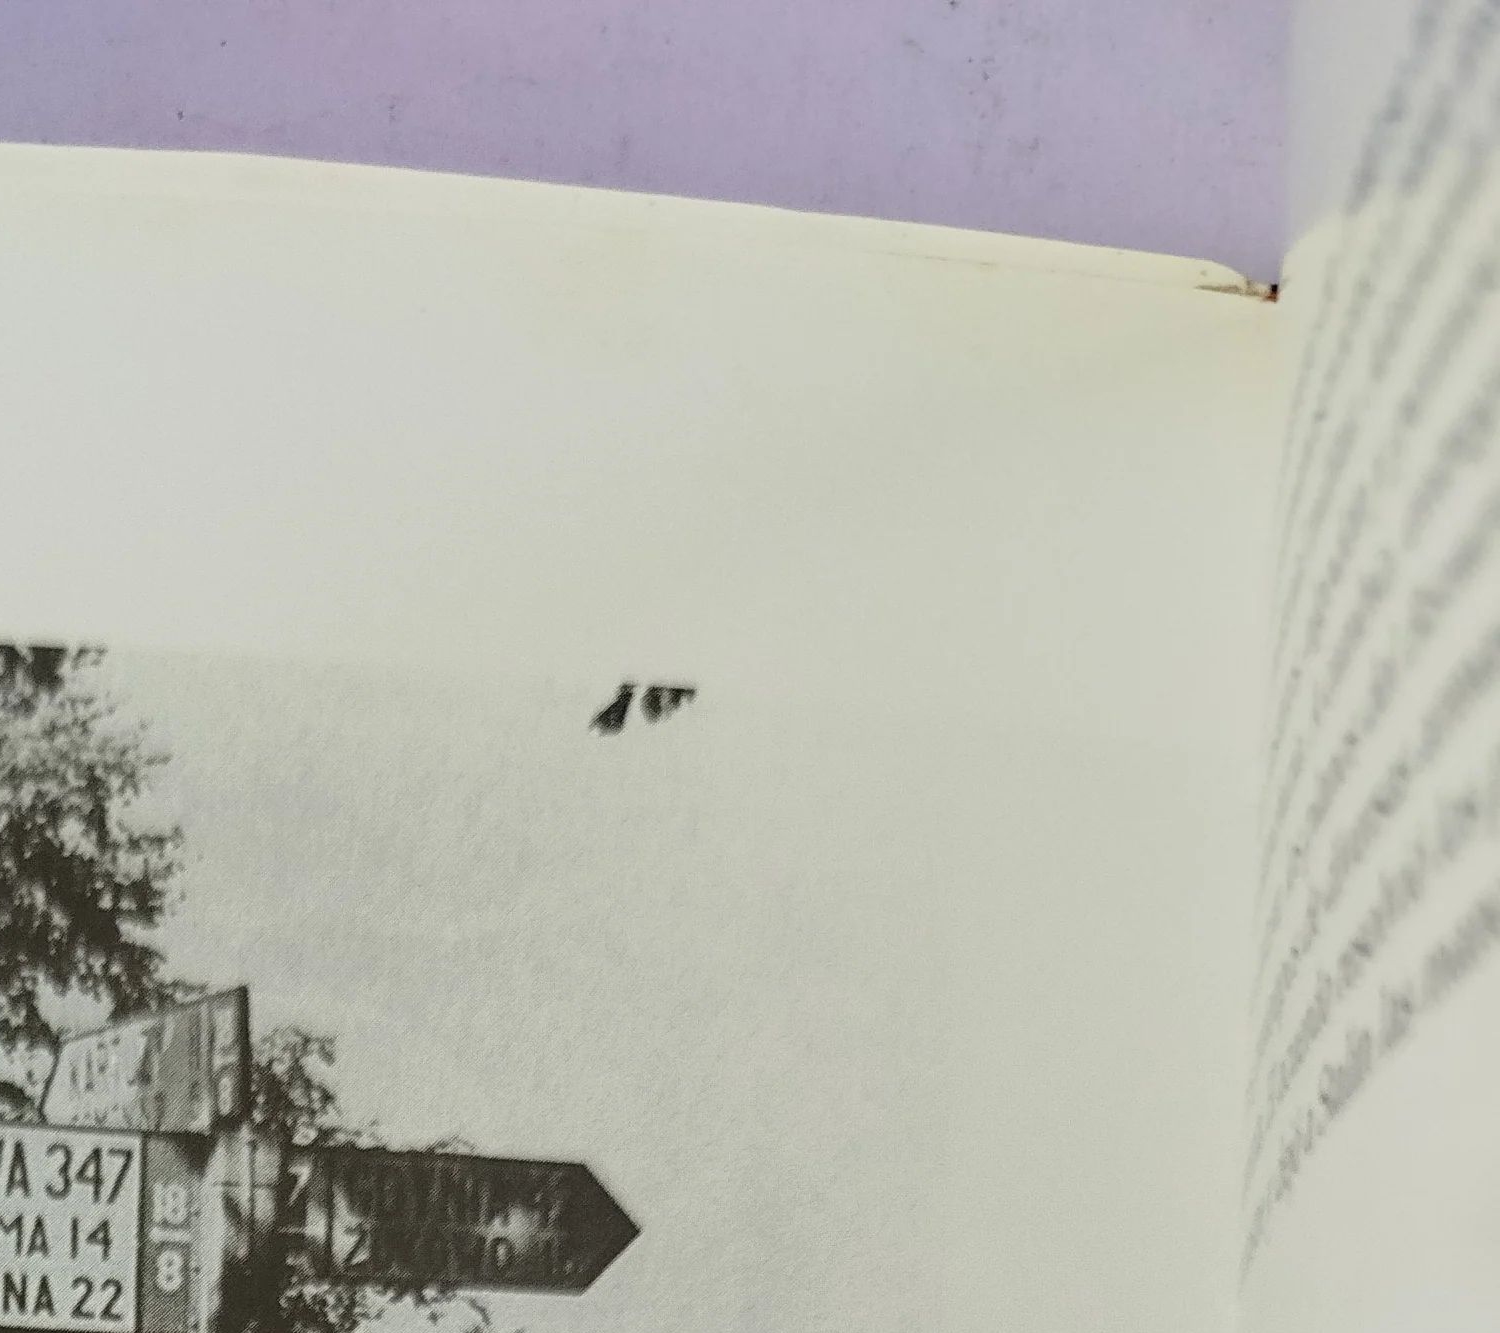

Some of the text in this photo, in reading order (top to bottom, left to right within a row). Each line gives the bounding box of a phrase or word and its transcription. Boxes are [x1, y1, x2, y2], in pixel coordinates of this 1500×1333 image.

[44, 1142, 133, 1203] 347
[70, 1217, 113, 1262] 14
[70, 1276, 126, 1322] 22
